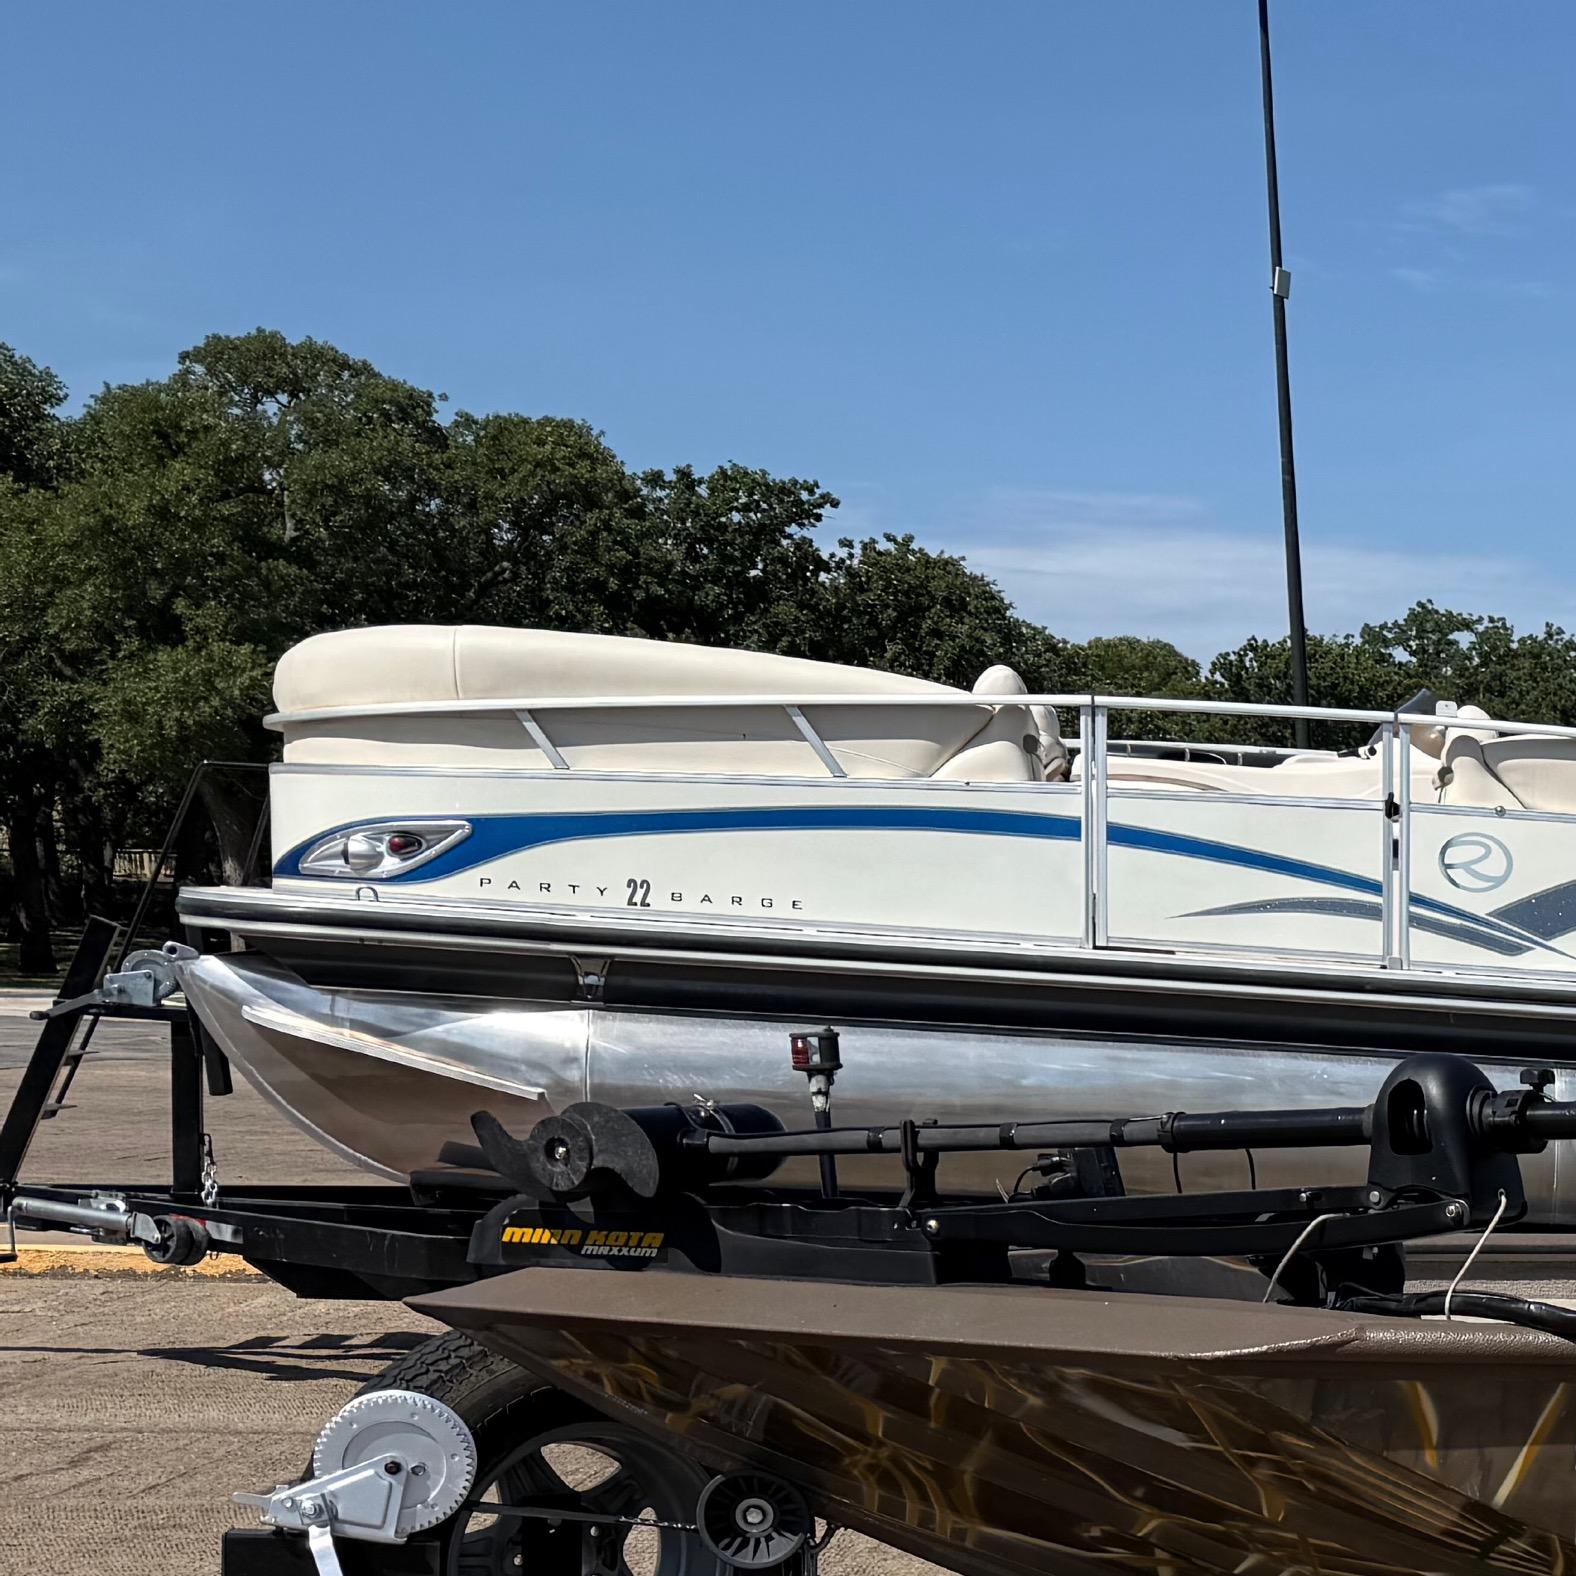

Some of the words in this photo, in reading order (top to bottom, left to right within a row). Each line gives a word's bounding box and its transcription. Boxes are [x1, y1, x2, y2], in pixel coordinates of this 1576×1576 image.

[479, 877, 608, 898] PARTY
[626, 877, 652, 907] 22
[670, 891, 803, 911] BARGE
